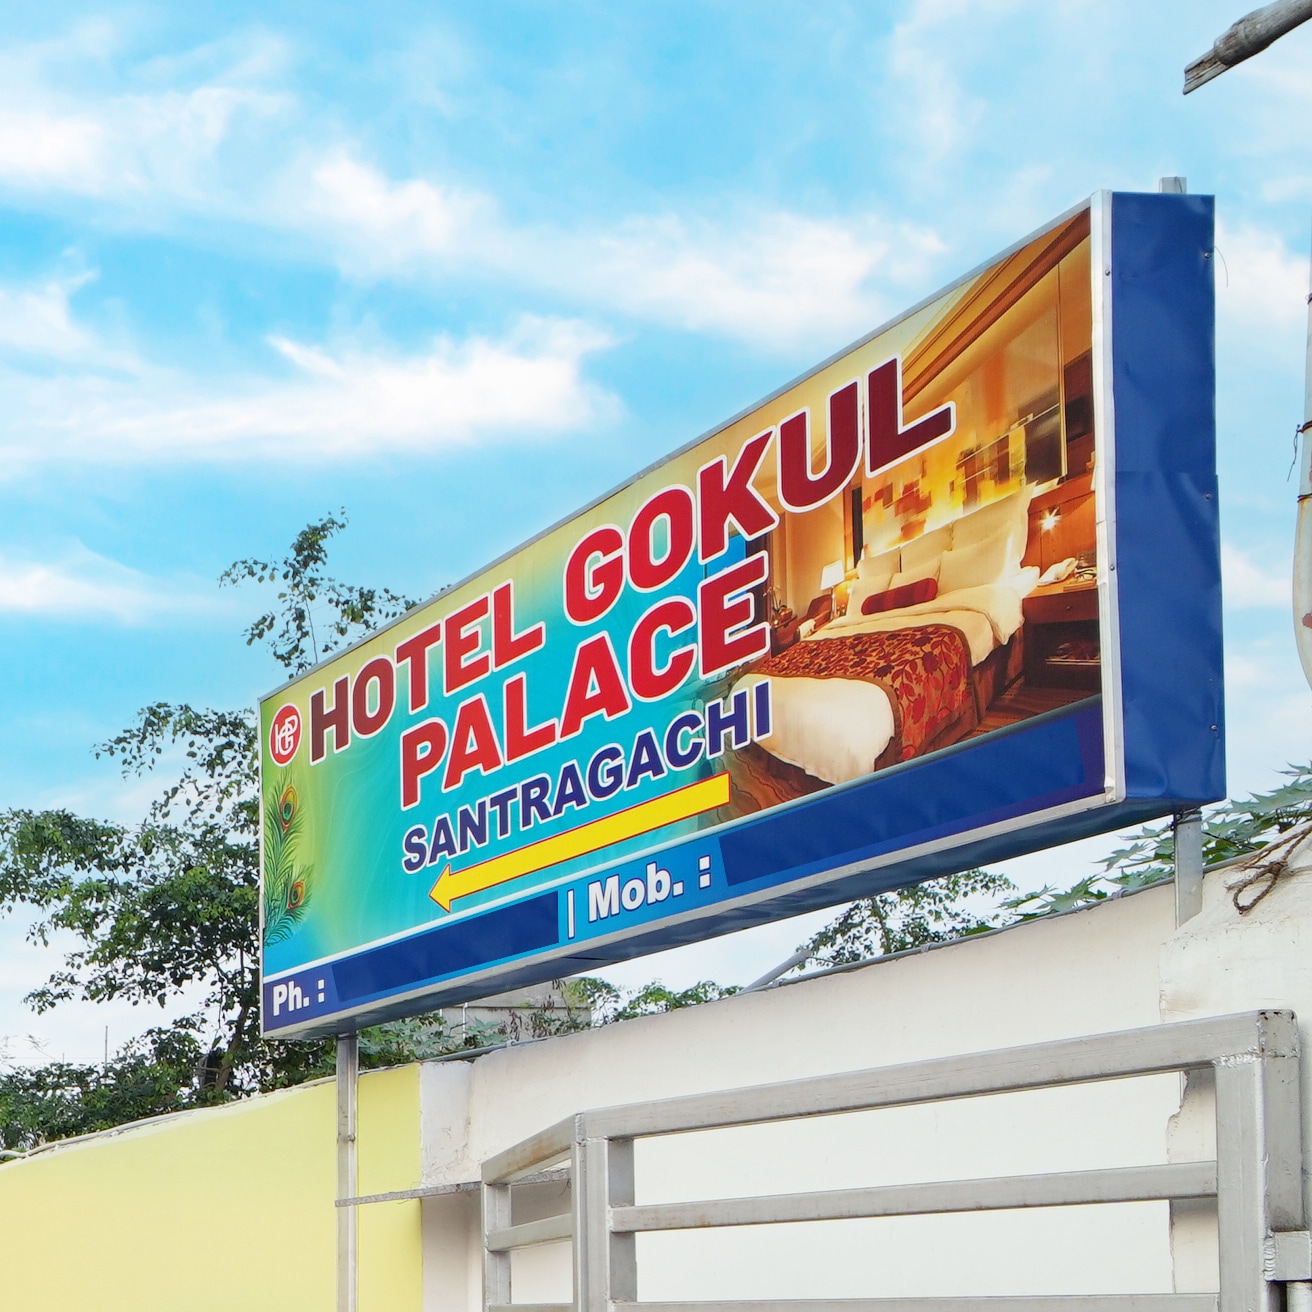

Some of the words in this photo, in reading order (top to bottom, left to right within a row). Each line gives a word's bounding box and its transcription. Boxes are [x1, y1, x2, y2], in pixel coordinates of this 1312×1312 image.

[308, 579, 546, 767] HOTEL
[564, 352, 958, 629] GOKUL
[399, 550, 772, 809] PALACE
[402, 681, 773, 875] SANTRAGACHI
[587, 862, 685, 924] Mob.
[271, 983, 311, 1017] Ph.
